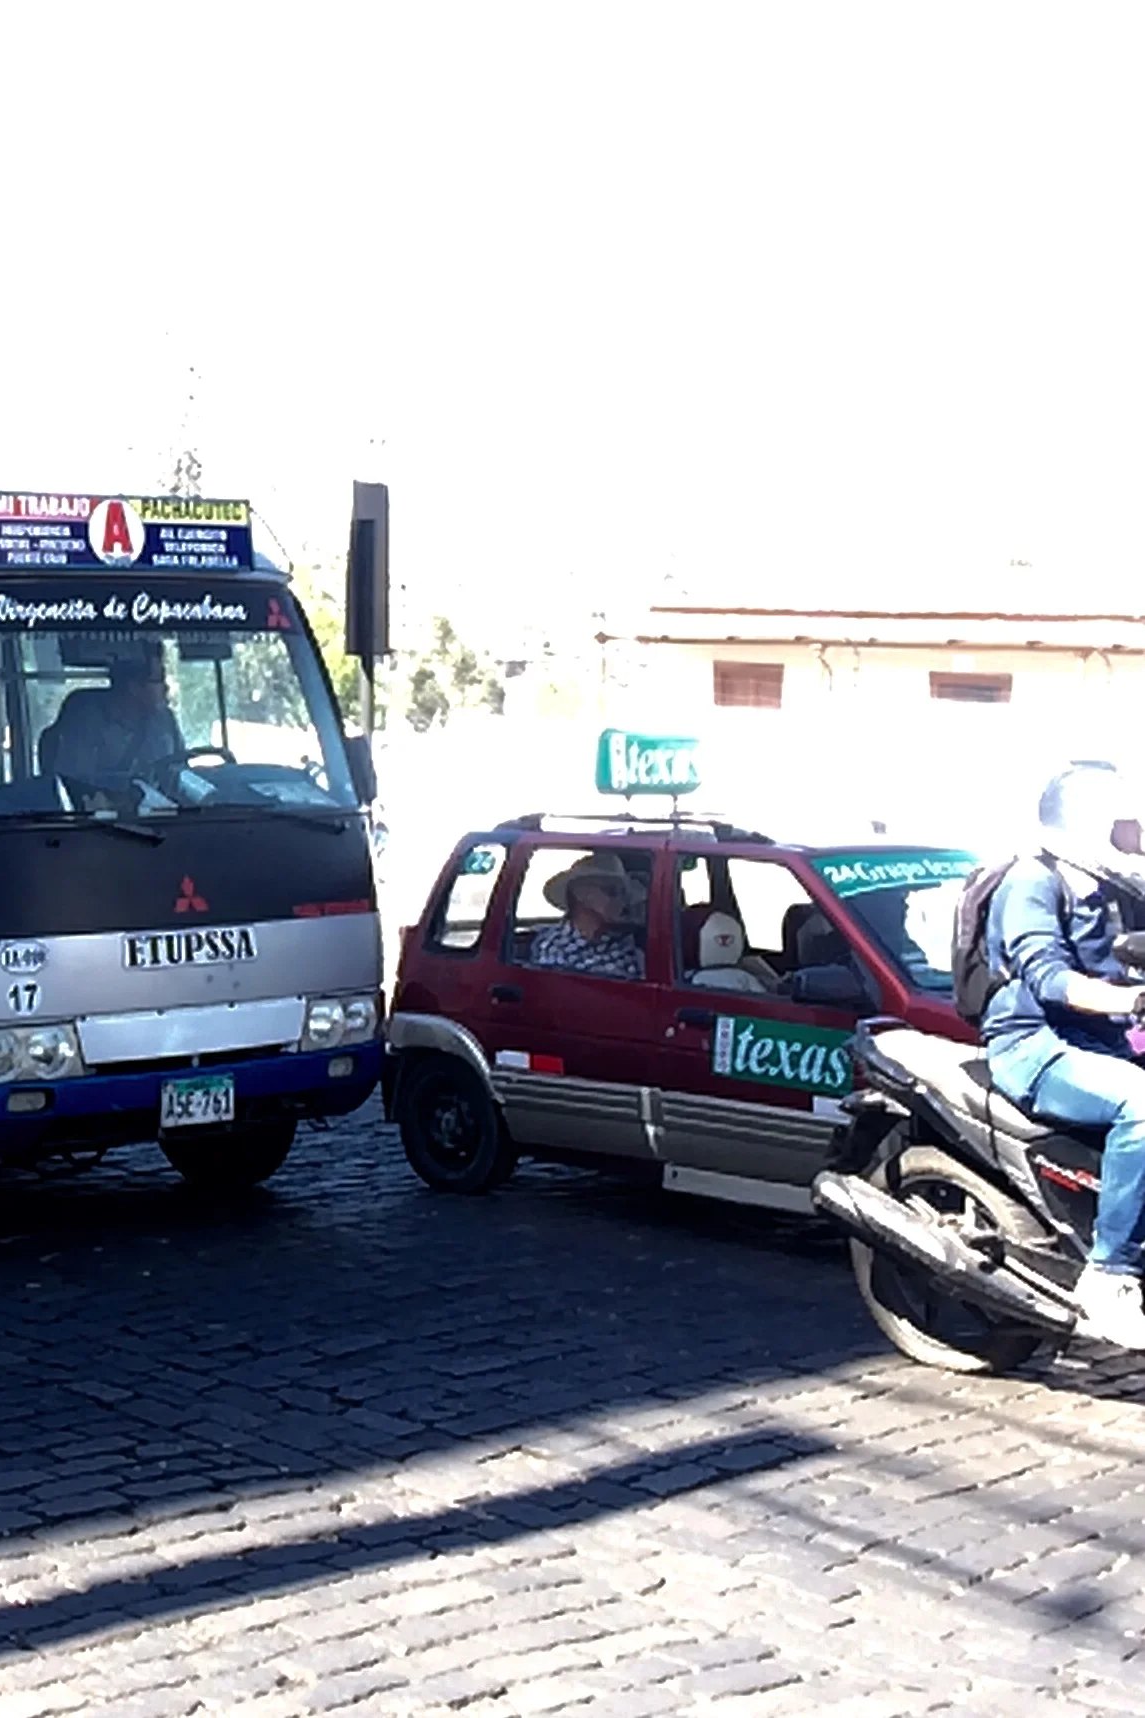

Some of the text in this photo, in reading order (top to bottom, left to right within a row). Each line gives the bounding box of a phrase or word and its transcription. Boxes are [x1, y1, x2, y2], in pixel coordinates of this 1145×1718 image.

[17, 494, 90, 517] TRABAJO
[140, 500, 244, 521] PACHACUTEC
[102, 501, 134, 553] A
[103, 596, 126, 620] de
[132, 592, 247, 624] Copacabana
[127, 929, 256, 967] ETUPSSA
[8, 983, 38, 1013] 17
[735, 1022, 850, 1088] texas
